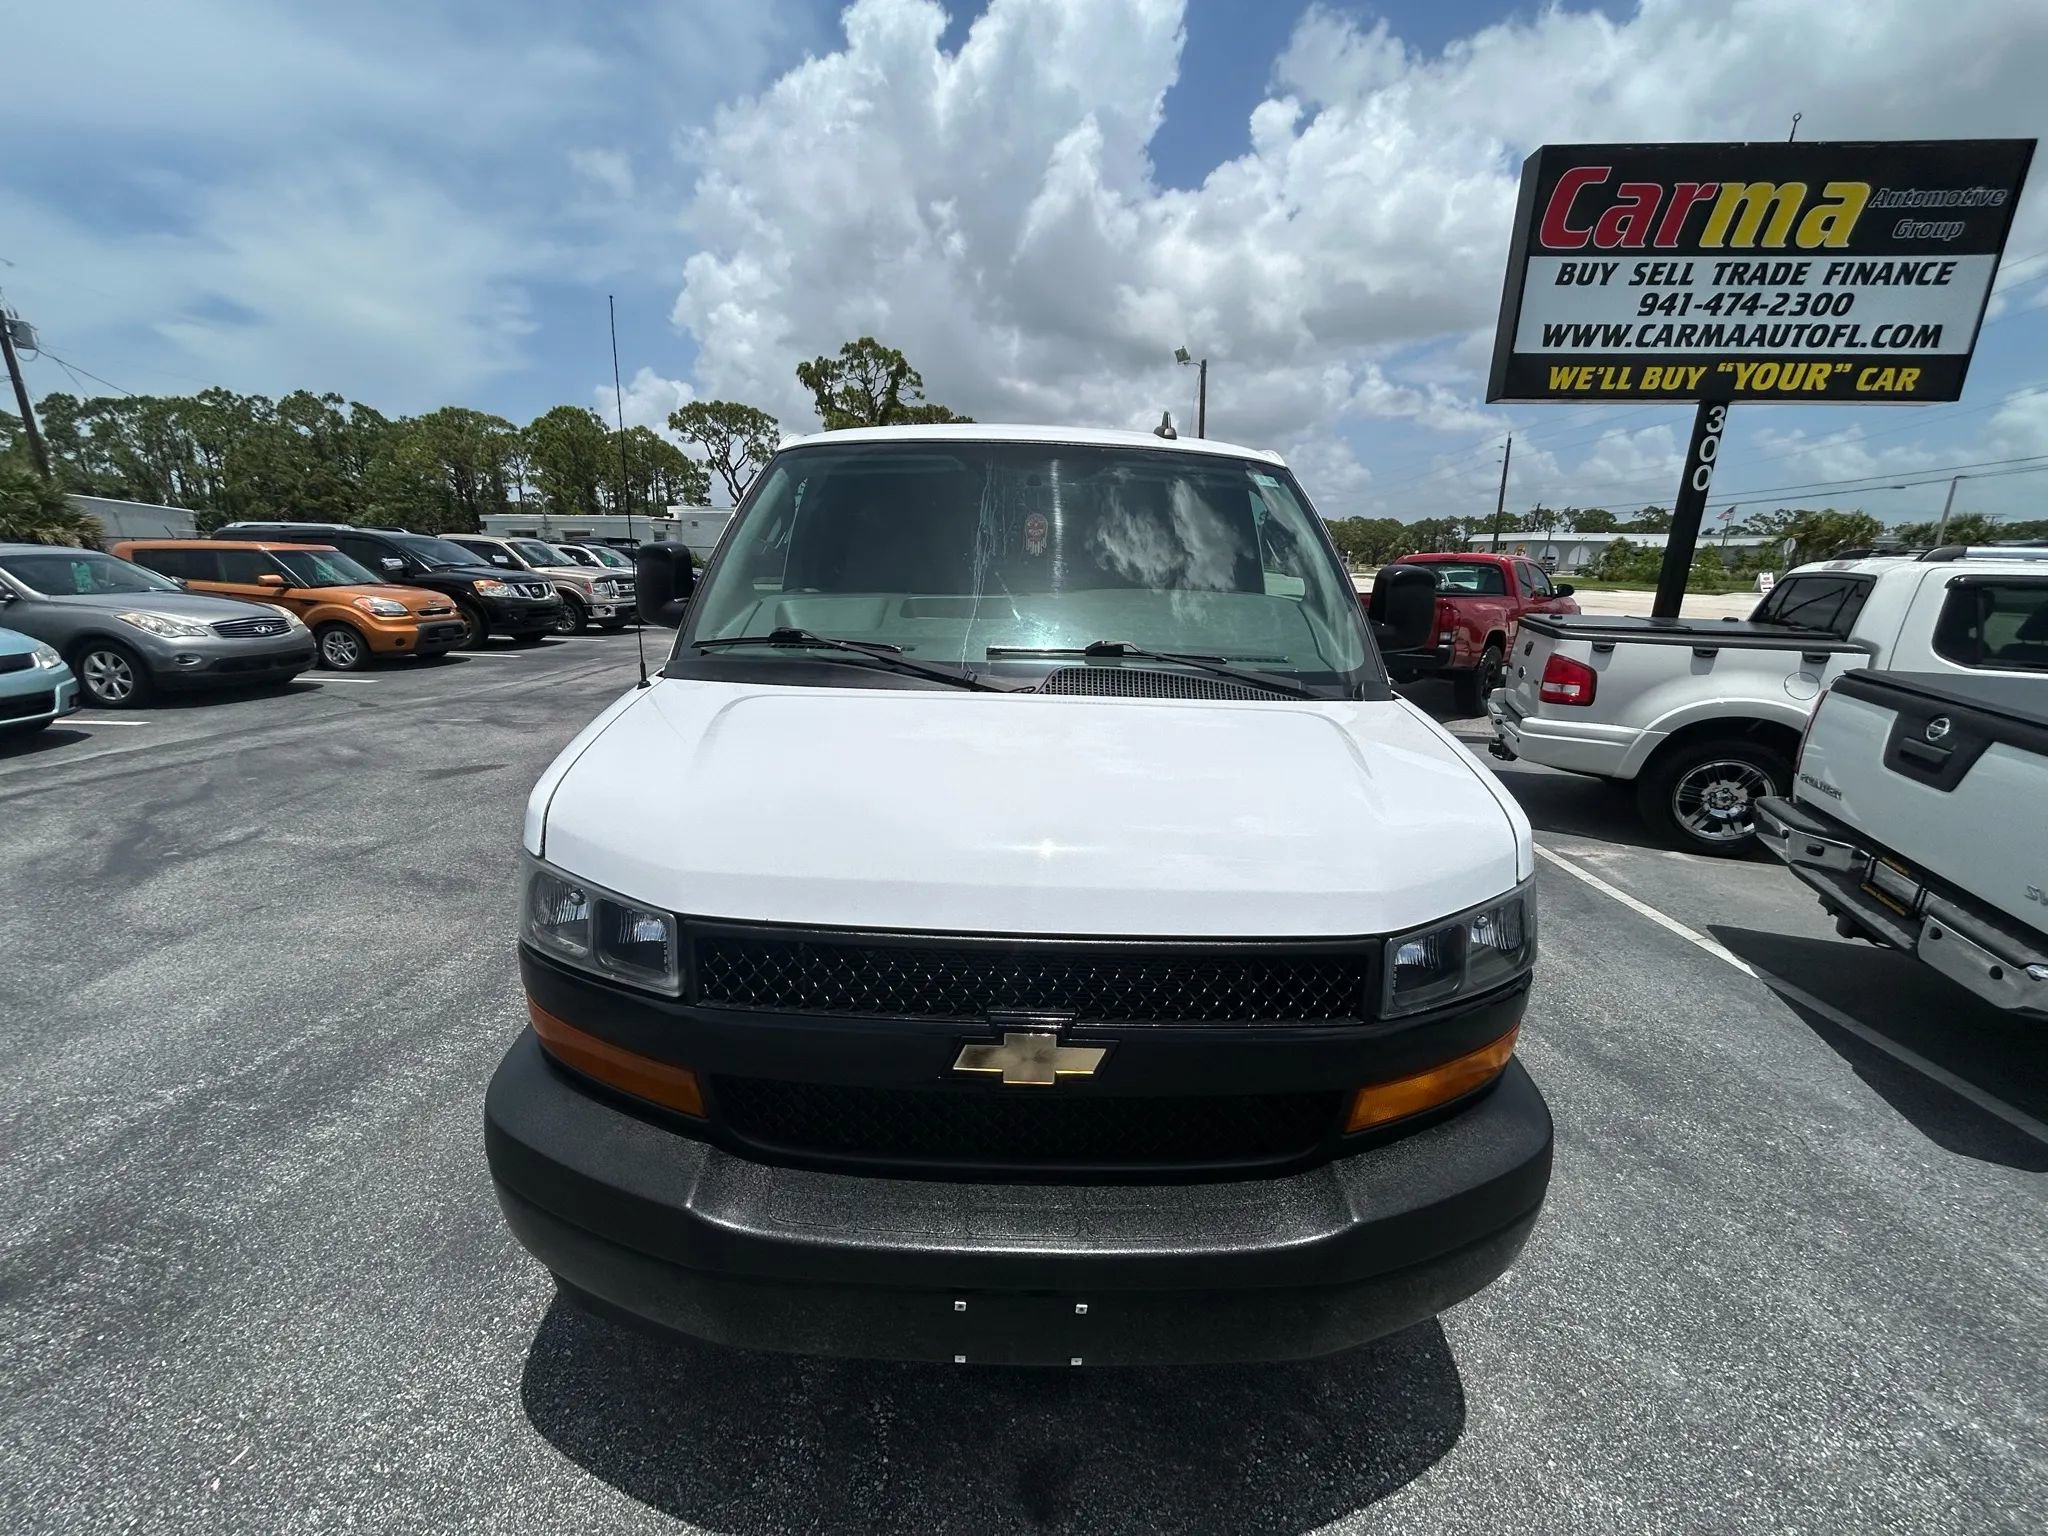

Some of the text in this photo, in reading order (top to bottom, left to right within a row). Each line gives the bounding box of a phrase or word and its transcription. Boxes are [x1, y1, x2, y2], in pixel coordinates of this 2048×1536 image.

[1540, 166, 1871, 248] Carma
[1868, 186, 2009, 208] Automotive
[1892, 218, 1966, 242] Group
[1555, 261, 1958, 286] BUY SELL TRADE FINANCE
[1637, 292, 1855, 317] 941-474-2300
[1542, 323, 1943, 348] WWW.CARMAAUTOFL.COM
[1549, 366, 1632, 390] WE'LL
[1639, 366, 1708, 390] BUY
[1856, 367, 1921, 391] CAR
[1692, 405, 1726, 492] 300
